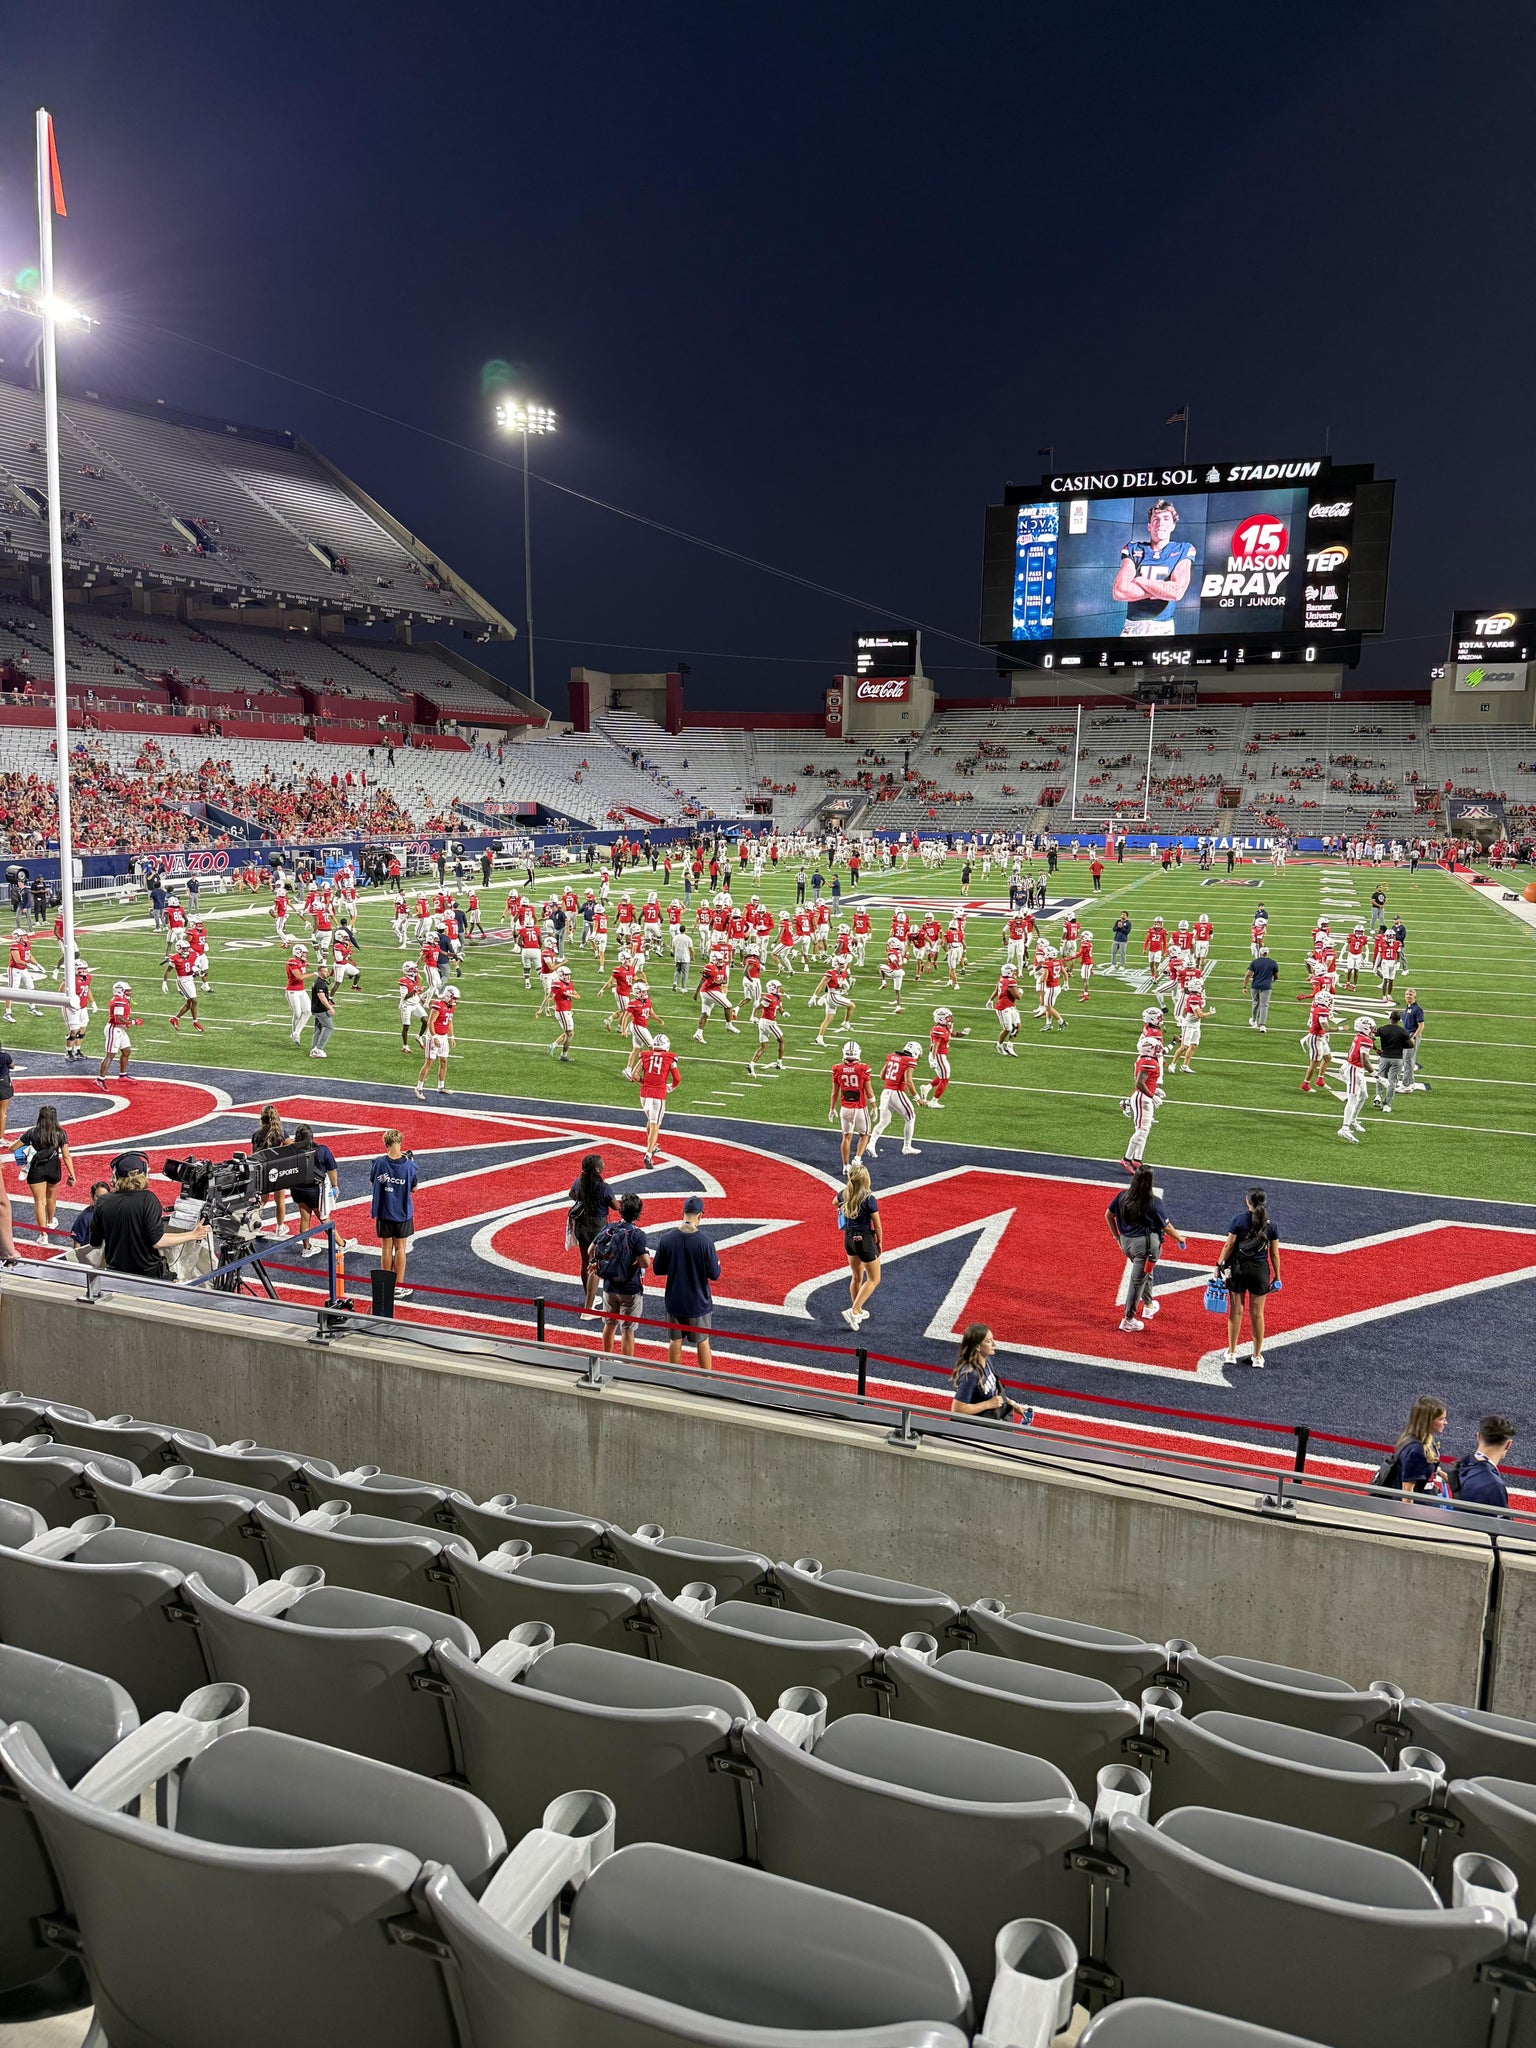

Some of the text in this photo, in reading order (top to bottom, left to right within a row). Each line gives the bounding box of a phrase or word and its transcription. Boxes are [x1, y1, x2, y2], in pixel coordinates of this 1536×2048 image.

[1050, 461, 1321, 492] CASINO DEL SOL STADIUM
[1240, 523, 1284, 555] 15
[1227, 554, 1290, 573] MASON
[1306, 554, 1344, 572] TEP
[1200, 571, 1290, 598] BRAY
[1220, 598, 1235, 607] QB
[1247, 596, 1286, 607] JUNIOR
[1306, 603, 1332, 612] Banner
[1306, 612, 1342, 621] University
[1304, 620, 1338, 628] Medicine
[1475, 620, 1510, 635] TEP
[1101, 652, 1107, 661] 3
[1152, 650, 1191, 665] 45:42
[1238, 649, 1244, 658] 3
[1306, 647, 1315, 661] 0
[1044, 654, 1053, 668] 0
[1431, 668, 1445, 678] 25
[88, 690, 93, 699] 5
[857, 680, 908, 698] Coca-Cola
[246, 699, 251, 708] 6
[230, 826, 237, 836] 6
[188, 850, 230, 873] ZOO
[647, 910, 656, 919] 73
[526, 930, 536, 941] 76
[1178, 938, 1186, 948] 51
[1355, 942, 1359, 950] 8
[185, 962, 190, 972] 8
[649, 1056, 662, 1074] 14
[886, 1061, 899, 1080] 32
[279, 1167, 299, 1178] SPORTS
